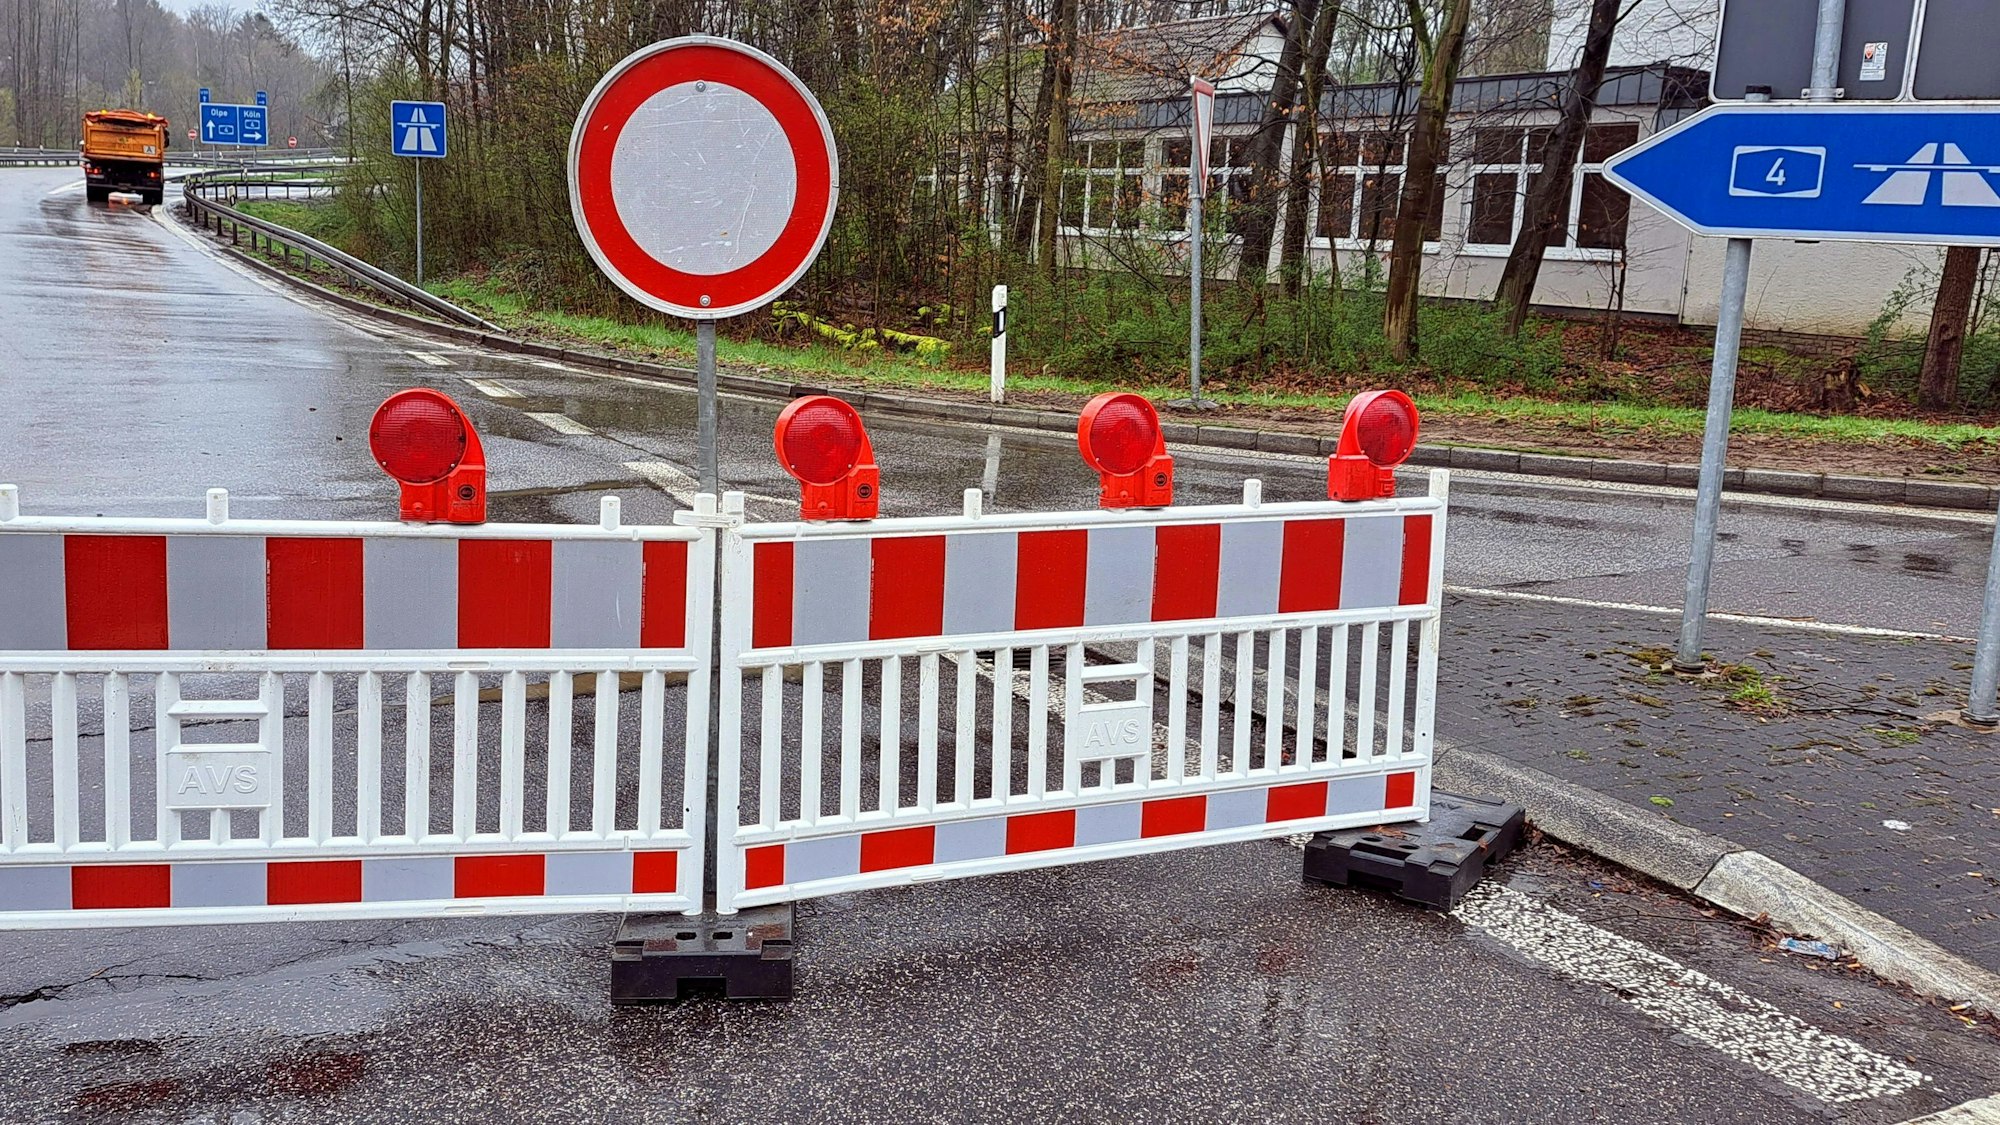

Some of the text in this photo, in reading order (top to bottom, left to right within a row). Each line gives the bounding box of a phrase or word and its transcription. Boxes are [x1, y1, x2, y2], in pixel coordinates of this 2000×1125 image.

[211, 108, 228, 118] Olpe
[243, 110, 261, 118] Köln
[1766, 157, 1786, 186] 4
[1084, 719, 1139, 748] AVS
[178, 764, 258, 794] AVS
